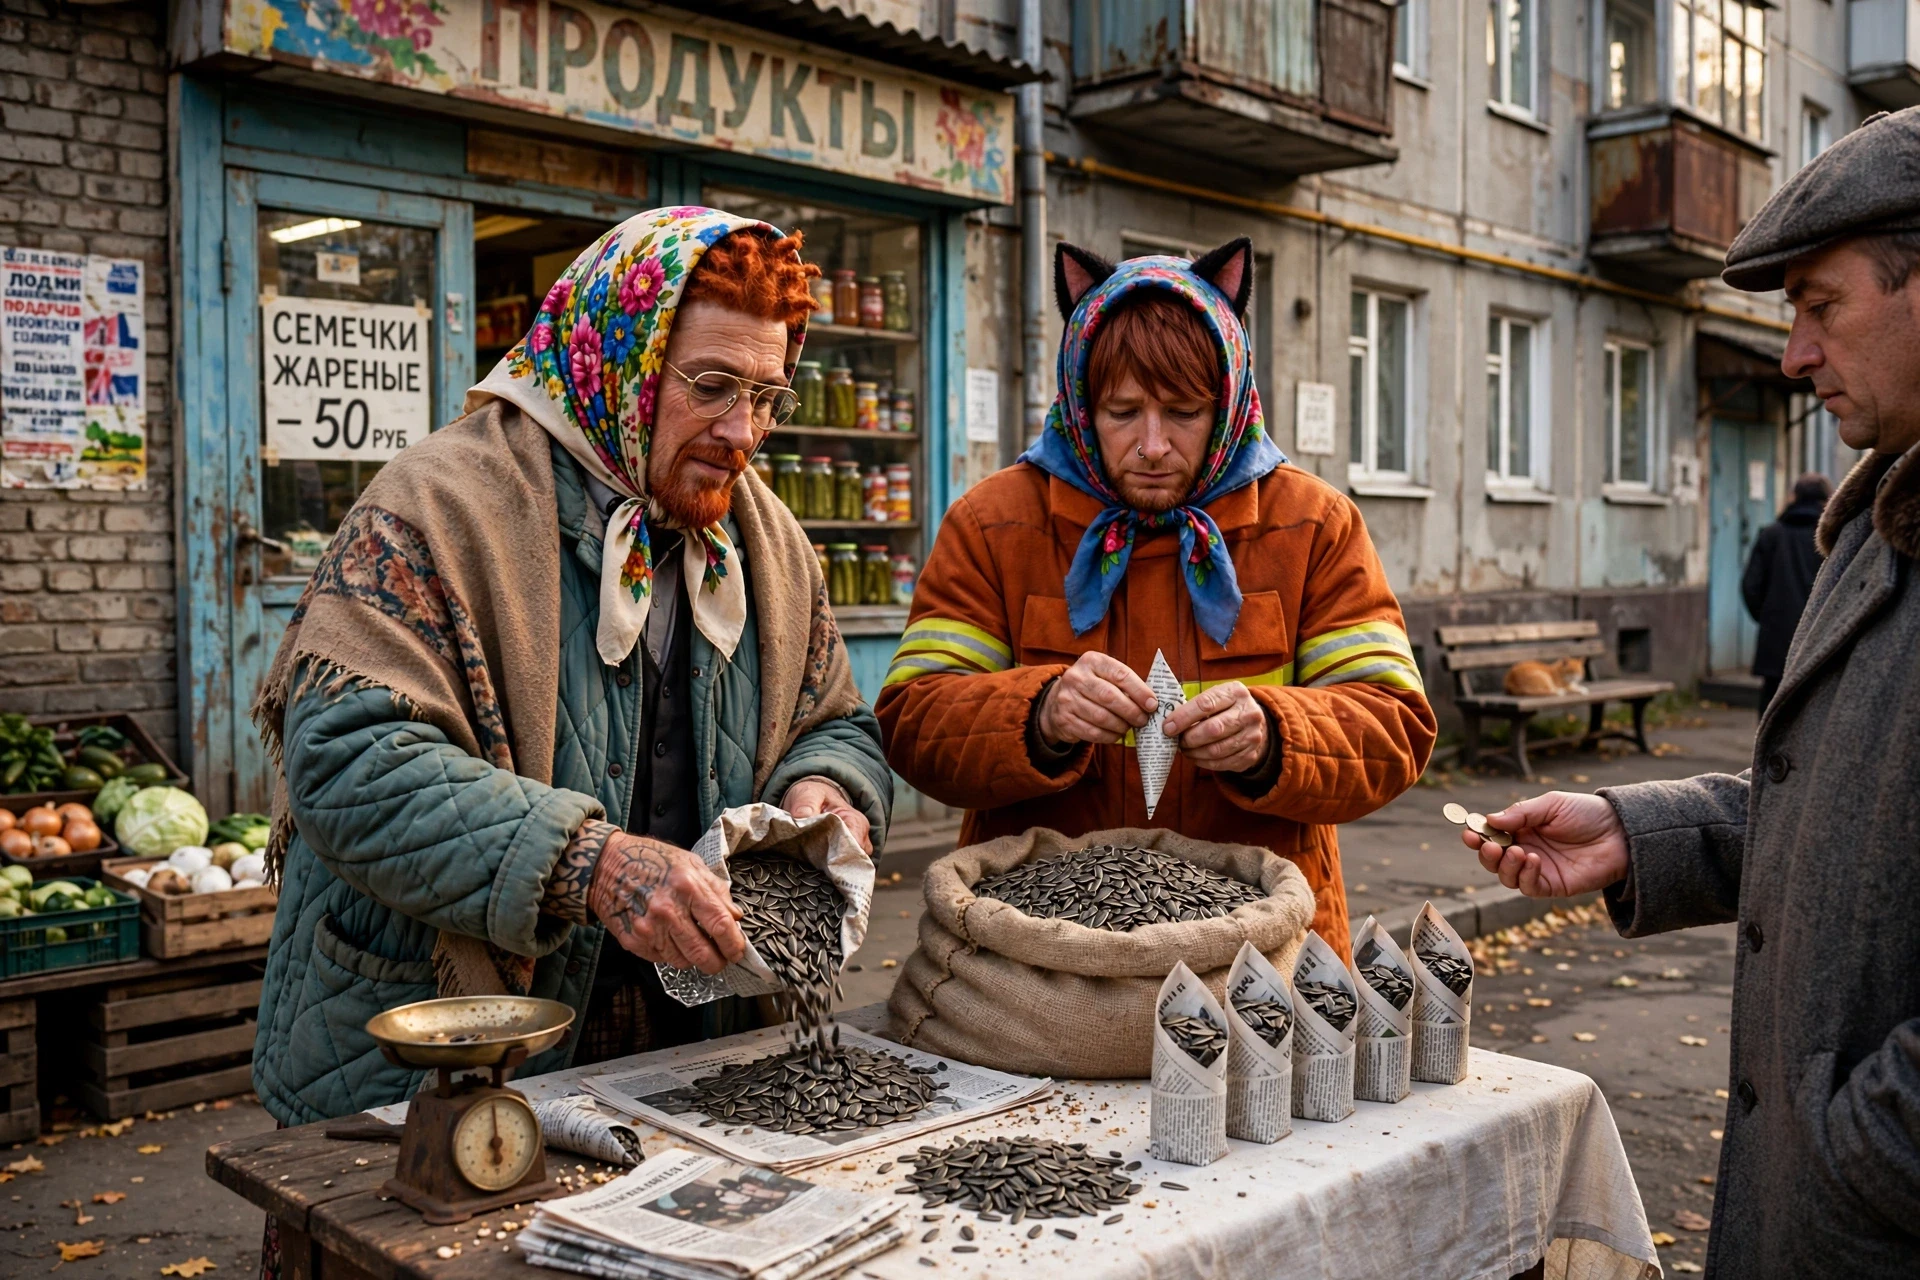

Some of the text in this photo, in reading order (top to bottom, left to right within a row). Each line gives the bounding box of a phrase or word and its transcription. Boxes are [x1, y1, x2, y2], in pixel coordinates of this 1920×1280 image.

[478, 0, 916, 164] ПРОДУКТЫ
[273, 311, 417, 352] СЕМЕЧКИ
[273, 354, 421, 392] ЖАРЕНЫЕ
